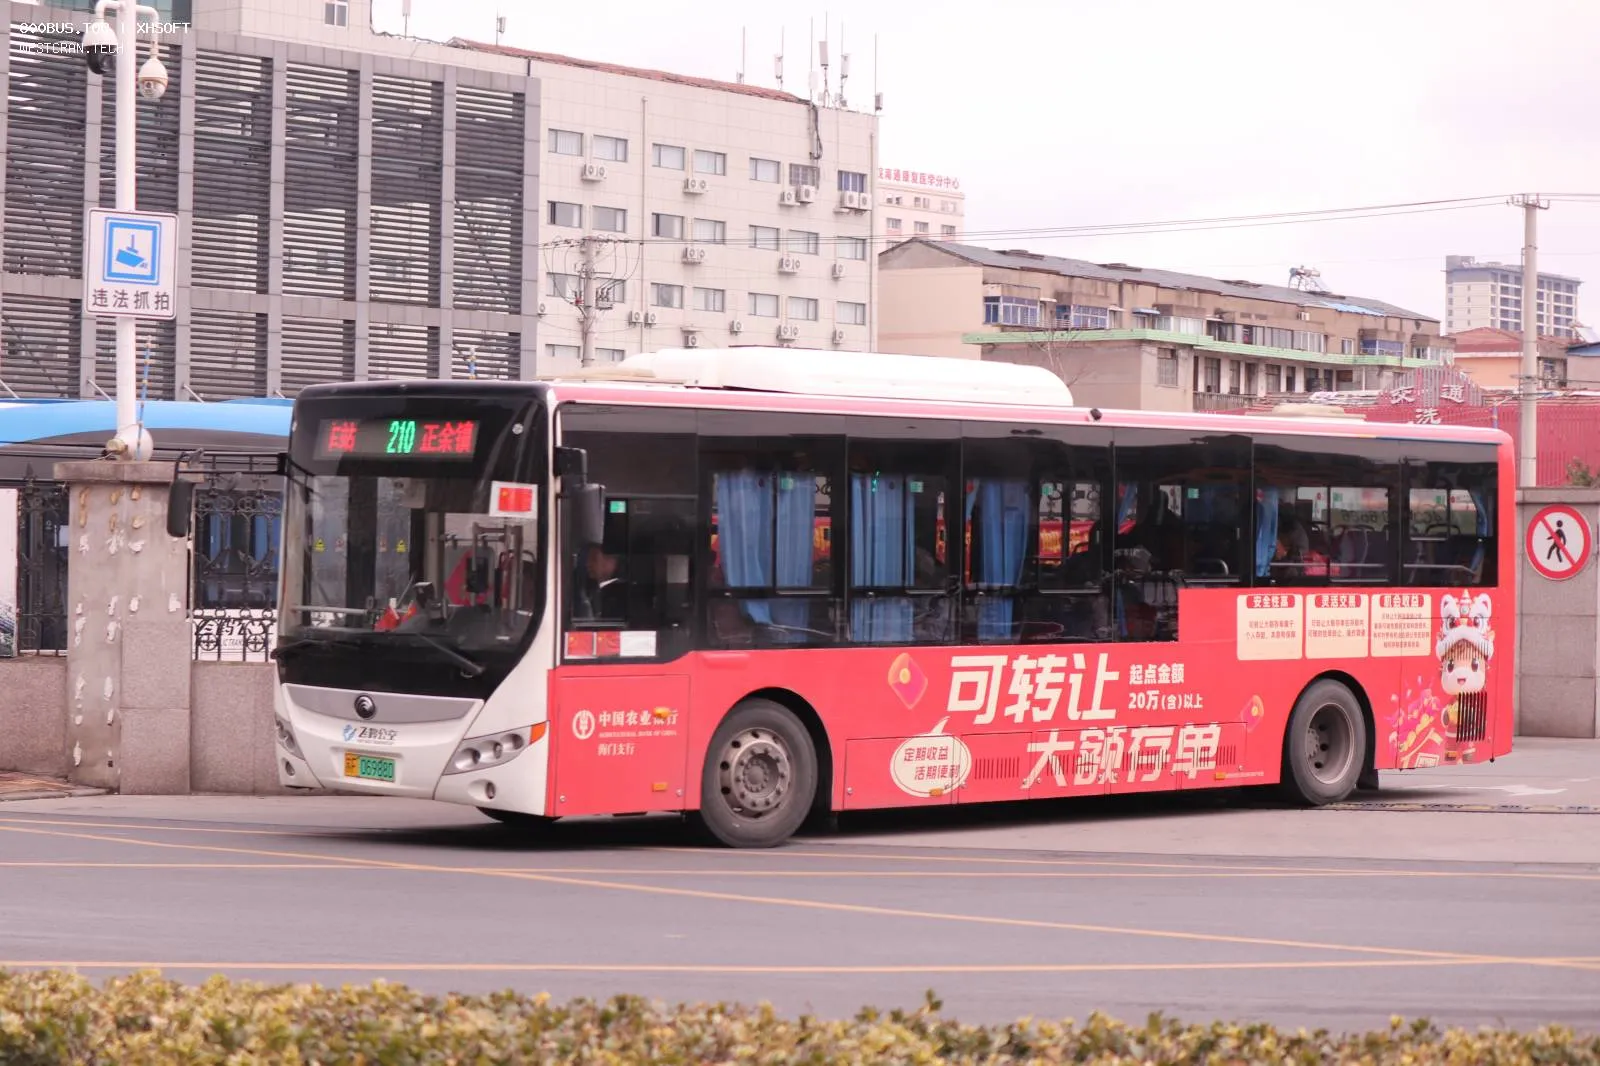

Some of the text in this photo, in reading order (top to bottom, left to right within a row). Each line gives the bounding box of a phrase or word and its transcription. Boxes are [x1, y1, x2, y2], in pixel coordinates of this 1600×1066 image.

[92, 288, 170, 310] 违法抓拍
[385, 420, 416, 454] 210
[419, 421, 475, 453] 正余镇
[1129, 663, 1185, 685] 起点金额
[947, 653, 1120, 724] 可转让
[904, 746, 949, 762] 定期收益
[1020, 722, 1222, 789] 大额存单
[914, 764, 961, 781] 活期便利
